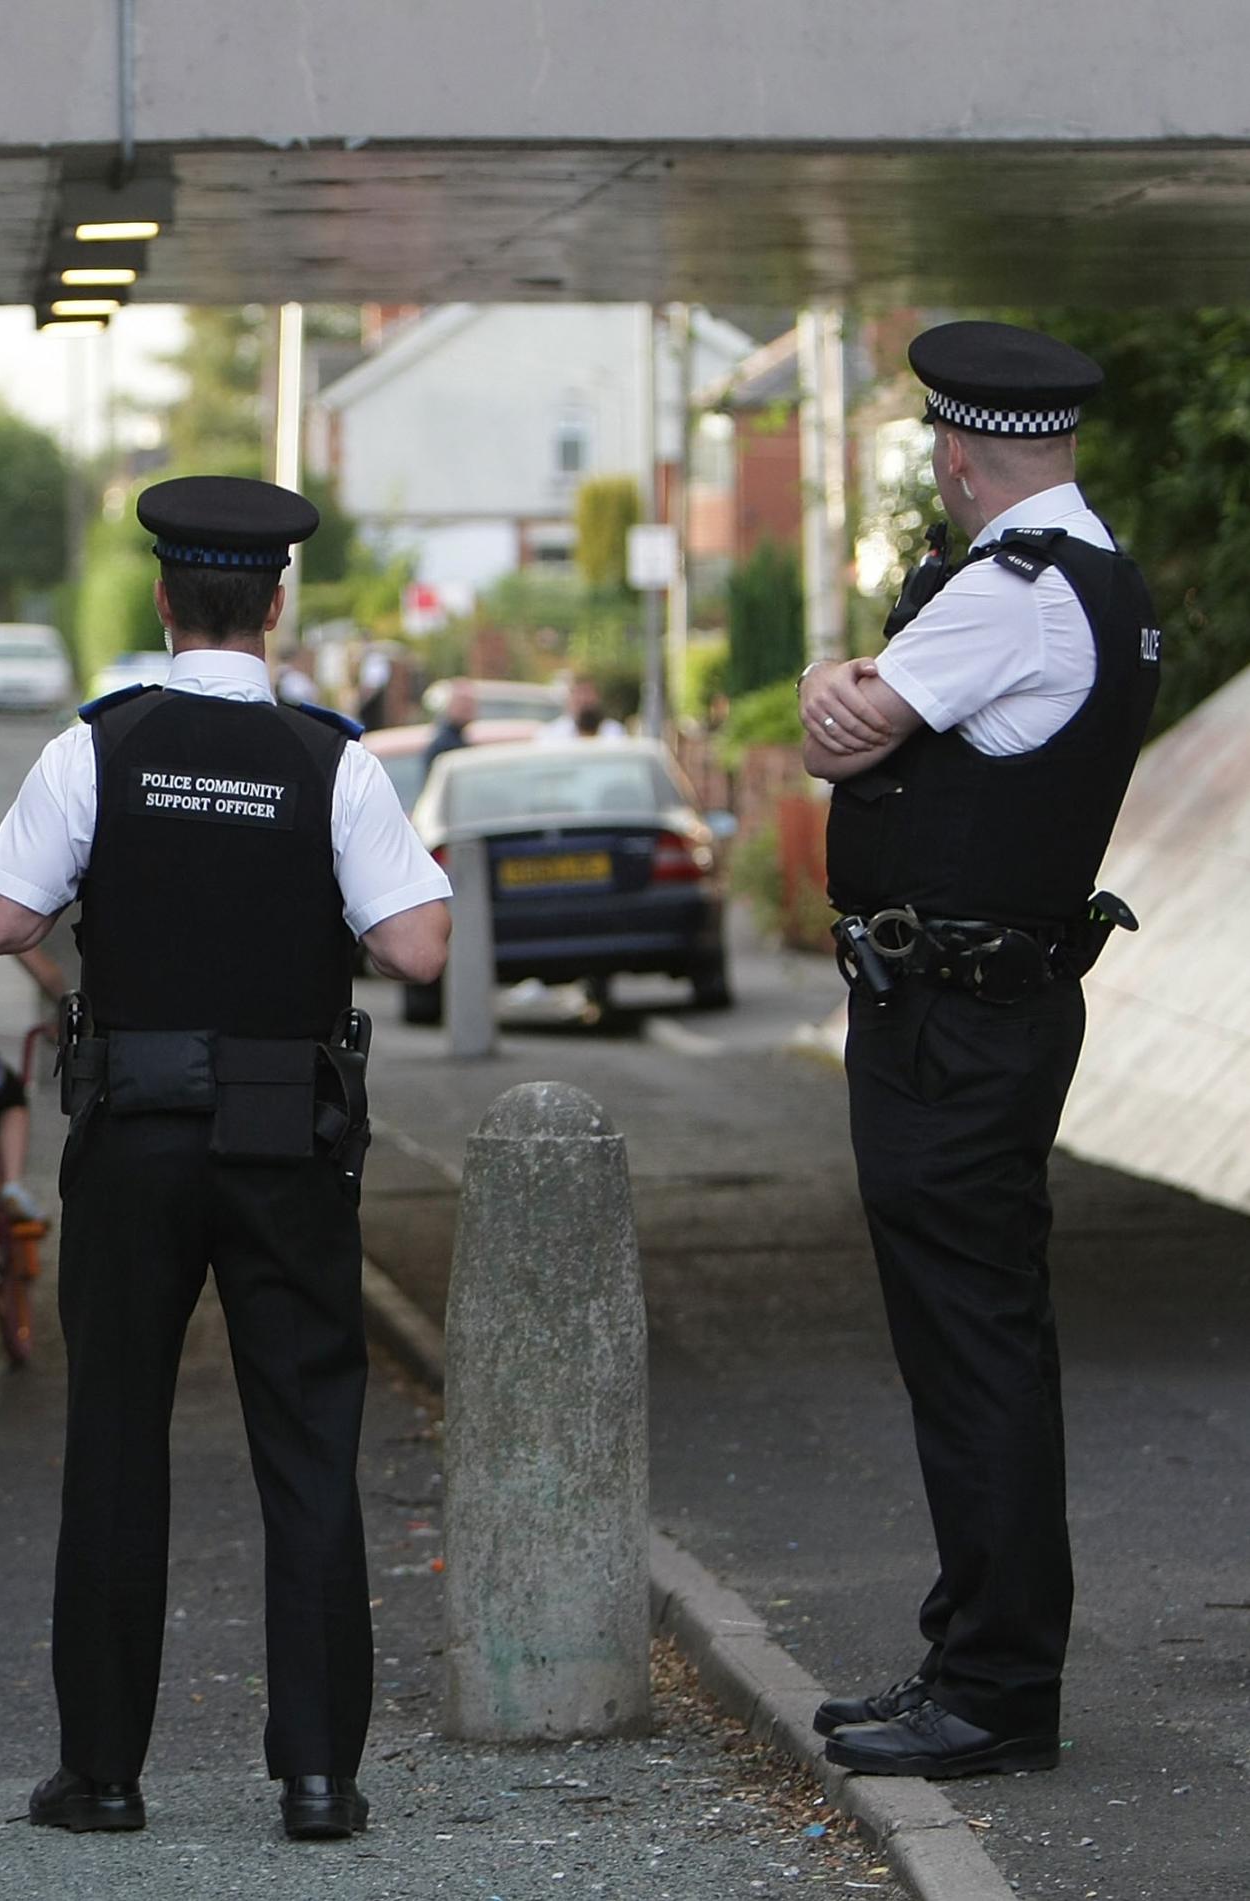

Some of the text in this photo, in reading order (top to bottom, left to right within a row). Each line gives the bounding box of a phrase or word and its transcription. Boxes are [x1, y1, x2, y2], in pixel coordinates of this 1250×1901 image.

[141, 773, 285, 800] POLICE COMMUNITY
[145, 792, 276, 818] SUPPORT OFFICER
